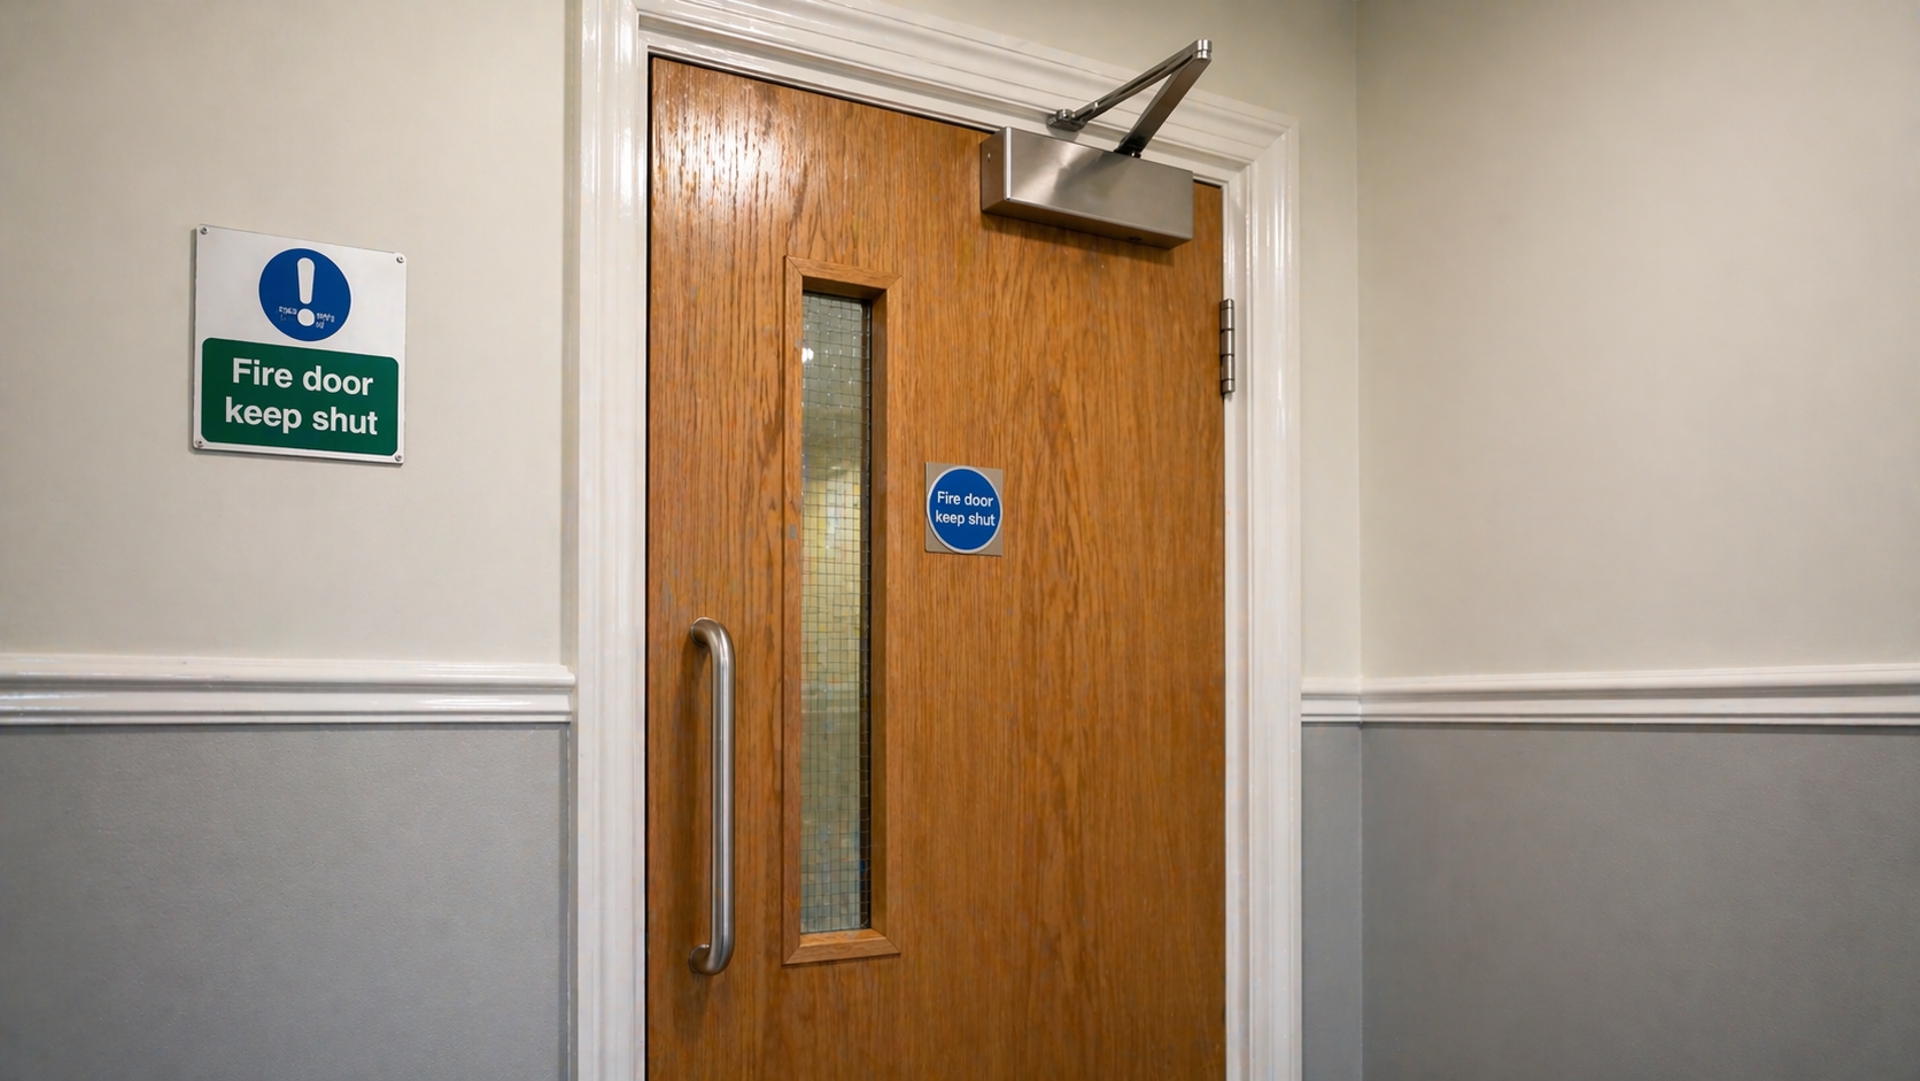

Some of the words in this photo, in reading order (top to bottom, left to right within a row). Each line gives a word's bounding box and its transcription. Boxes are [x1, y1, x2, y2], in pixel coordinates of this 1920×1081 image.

[232, 357, 293, 388] Fire
[302, 365, 374, 396] door
[225, 396, 302, 434] keep
[312, 406, 379, 435] shut
[937, 490, 961, 505] Fire
[964, 493, 994, 507] door
[935, 510, 965, 527] keep
[968, 512, 996, 526] shut
